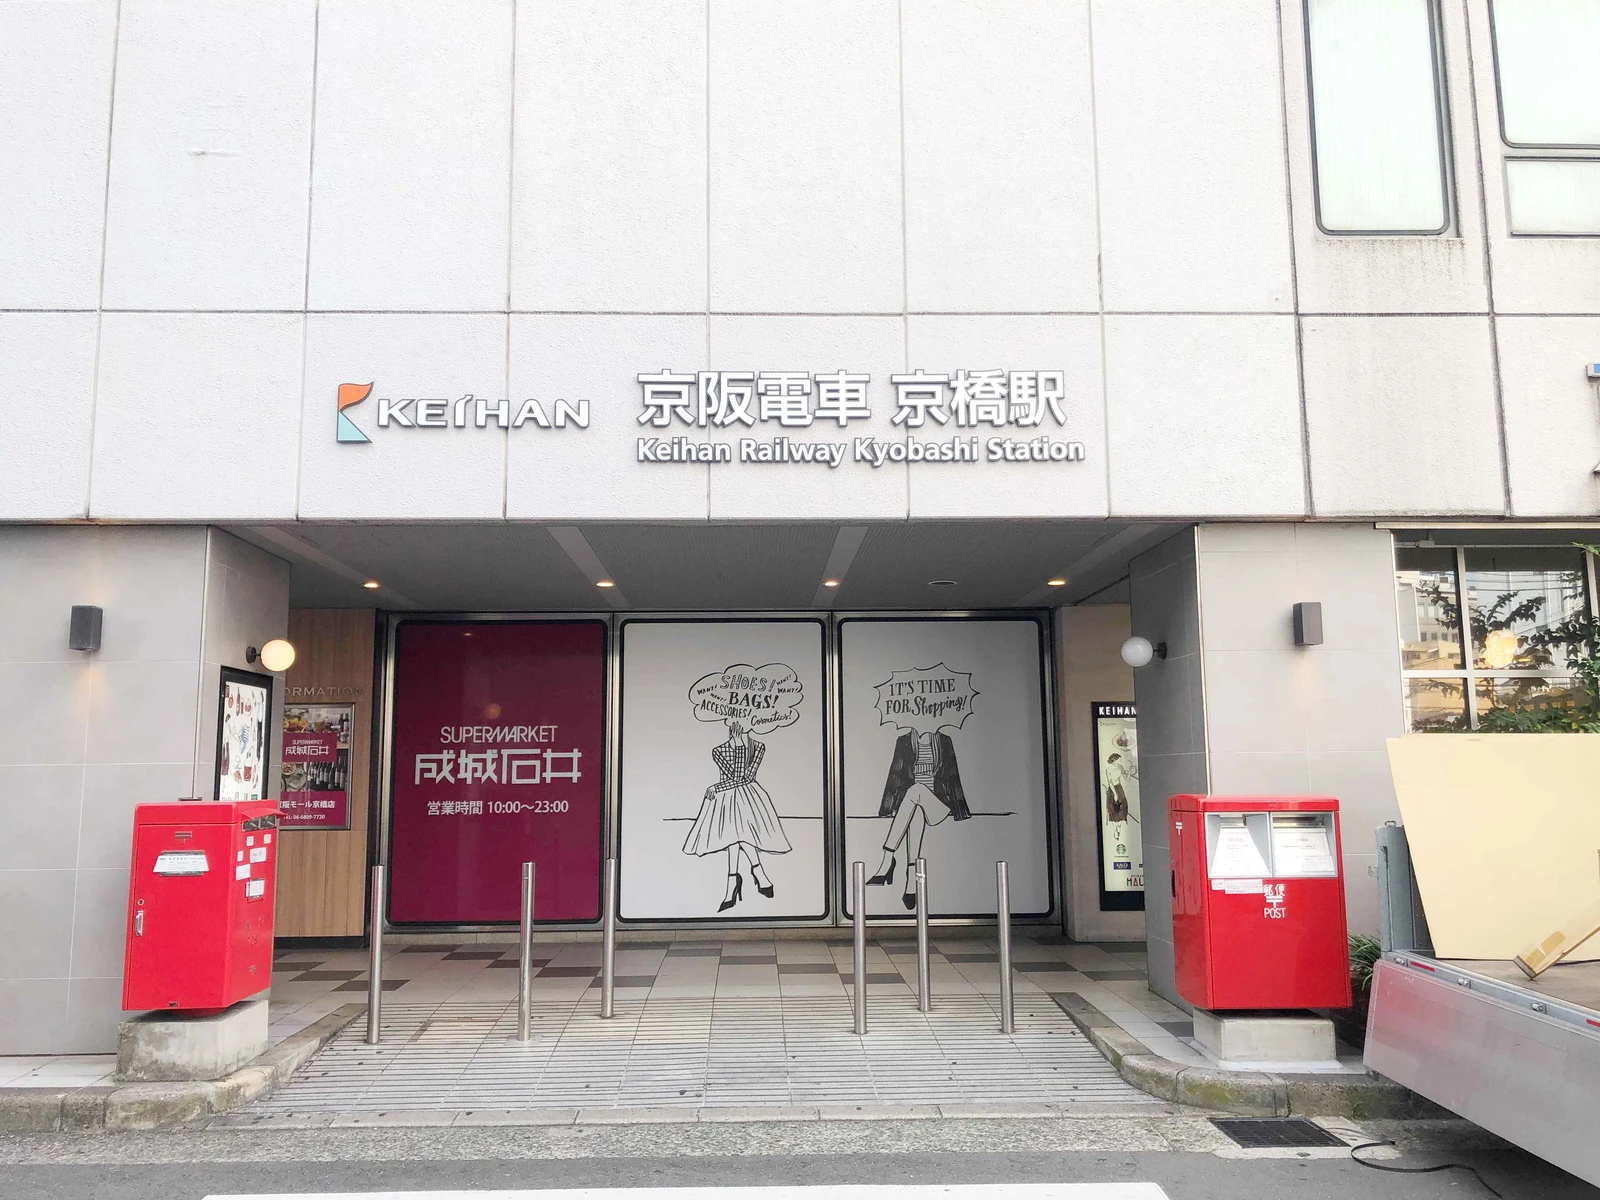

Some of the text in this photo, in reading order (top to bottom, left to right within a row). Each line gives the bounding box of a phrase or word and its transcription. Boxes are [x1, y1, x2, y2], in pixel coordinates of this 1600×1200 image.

[636, 368, 1068, 428] 京阪電車 京橋駅
[377, 394, 591, 429] KEIHAN
[637, 436, 1086, 468] Keihan Railway Kyobashi Station
[697, 684, 718, 695] WANT!
[720, 674, 776, 692] SHOES!
[889, 678, 956, 696] IT'S TIME
[700, 699, 752, 720] ACCESSORIES!
[728, 691, 779, 710] BAGS!
[885, 695, 968, 718] FOR Shopping!
[751, 710, 793, 726] Cosmetics!
[440, 725, 559, 743] SUPERMARKET
[415, 748, 582, 785] 成城石井
[427, 801, 483, 815] 営業時間
[1263, 883, 1285, 897] 郵便
[1263, 907, 1286, 919] POST
